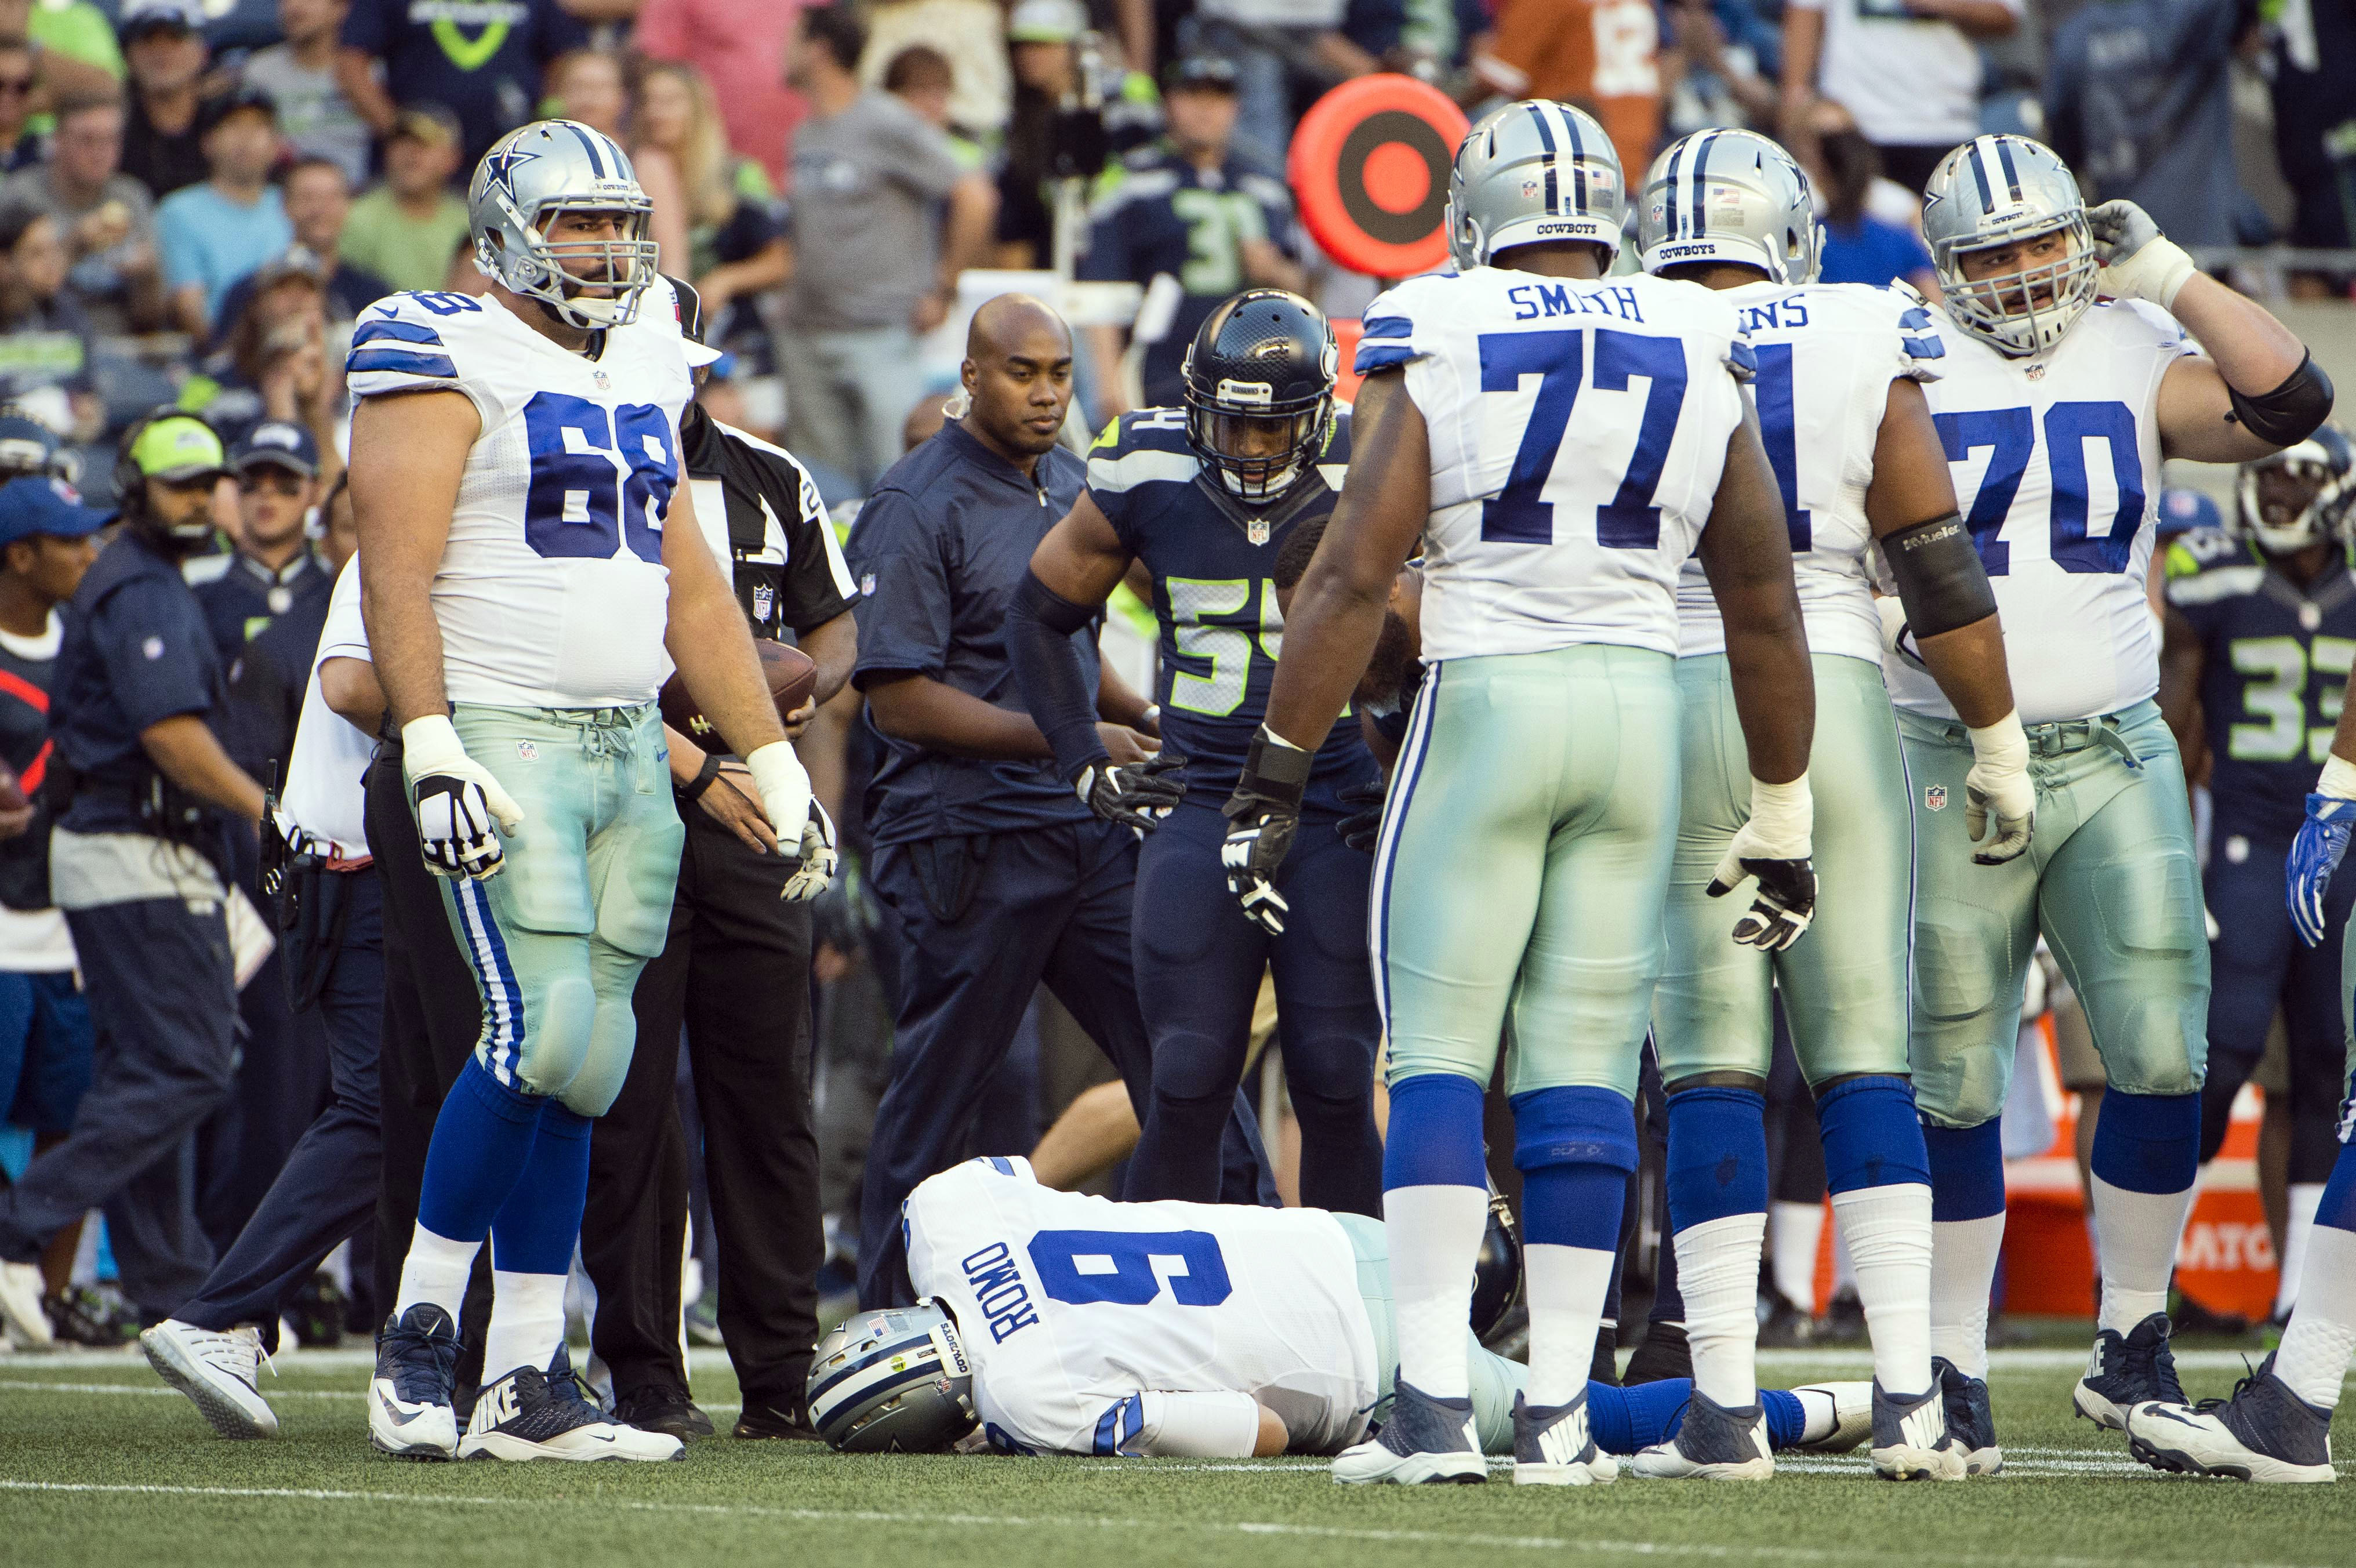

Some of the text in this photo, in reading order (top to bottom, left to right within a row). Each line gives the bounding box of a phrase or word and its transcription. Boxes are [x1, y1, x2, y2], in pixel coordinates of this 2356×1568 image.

[1537, 224, 1596, 235] COWBOYS
[1660, 244, 1715, 260] COWBOYS
[523, 391, 678, 564] 68
[1478, 329, 1687, 550] 77
[1932, 401, 2146, 576] 70
[962, 1242, 1040, 1345] ROMO
[1028, 1229, 1233, 1306] 9
[941, 1322, 968, 1373] COWBOYS
